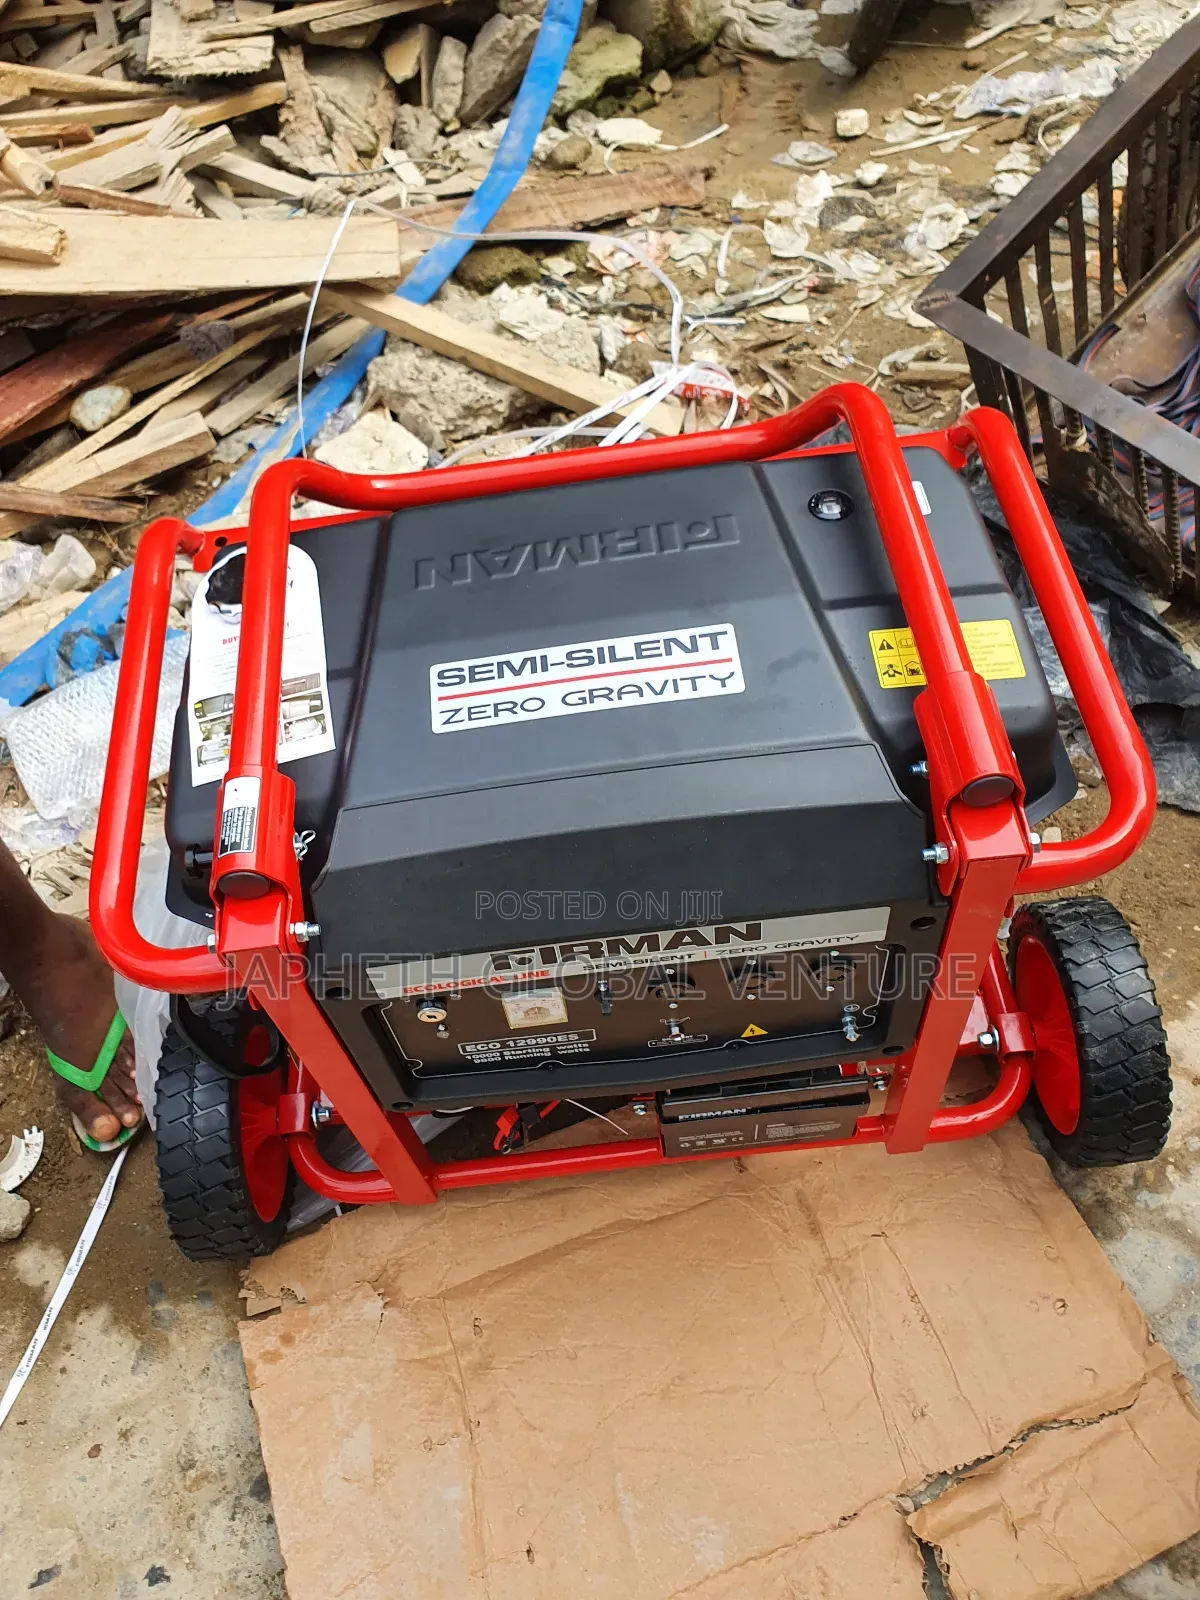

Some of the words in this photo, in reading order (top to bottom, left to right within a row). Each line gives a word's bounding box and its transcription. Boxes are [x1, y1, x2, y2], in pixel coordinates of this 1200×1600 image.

[437, 630, 728, 688] SEMI-SILENT
[439, 697, 545, 725] ZERO
[561, 671, 735, 706] GRAVITY
[489, 921, 763, 971] FIRMAN
[582, 952, 696, 971] SEMI-SILENT
[716, 944, 768, 956] ZERO
[774, 934, 860, 950] GRAVITY
[403, 973, 506, 994] ECOLOGICAL
[513, 969, 551, 981] LINE
[465, 1041, 500, 1053] ECO
[505, 1032, 579, 1048] 12990ES
[465, 1052, 500, 1061] 10000
[503, 1046, 550, 1058] Starting
[556, 1042, 589, 1051] watts
[504, 1051, 552, 1062] Running
[557, 1046, 590, 1055] watts
[678, 1107, 747, 1121] FIRMAN
